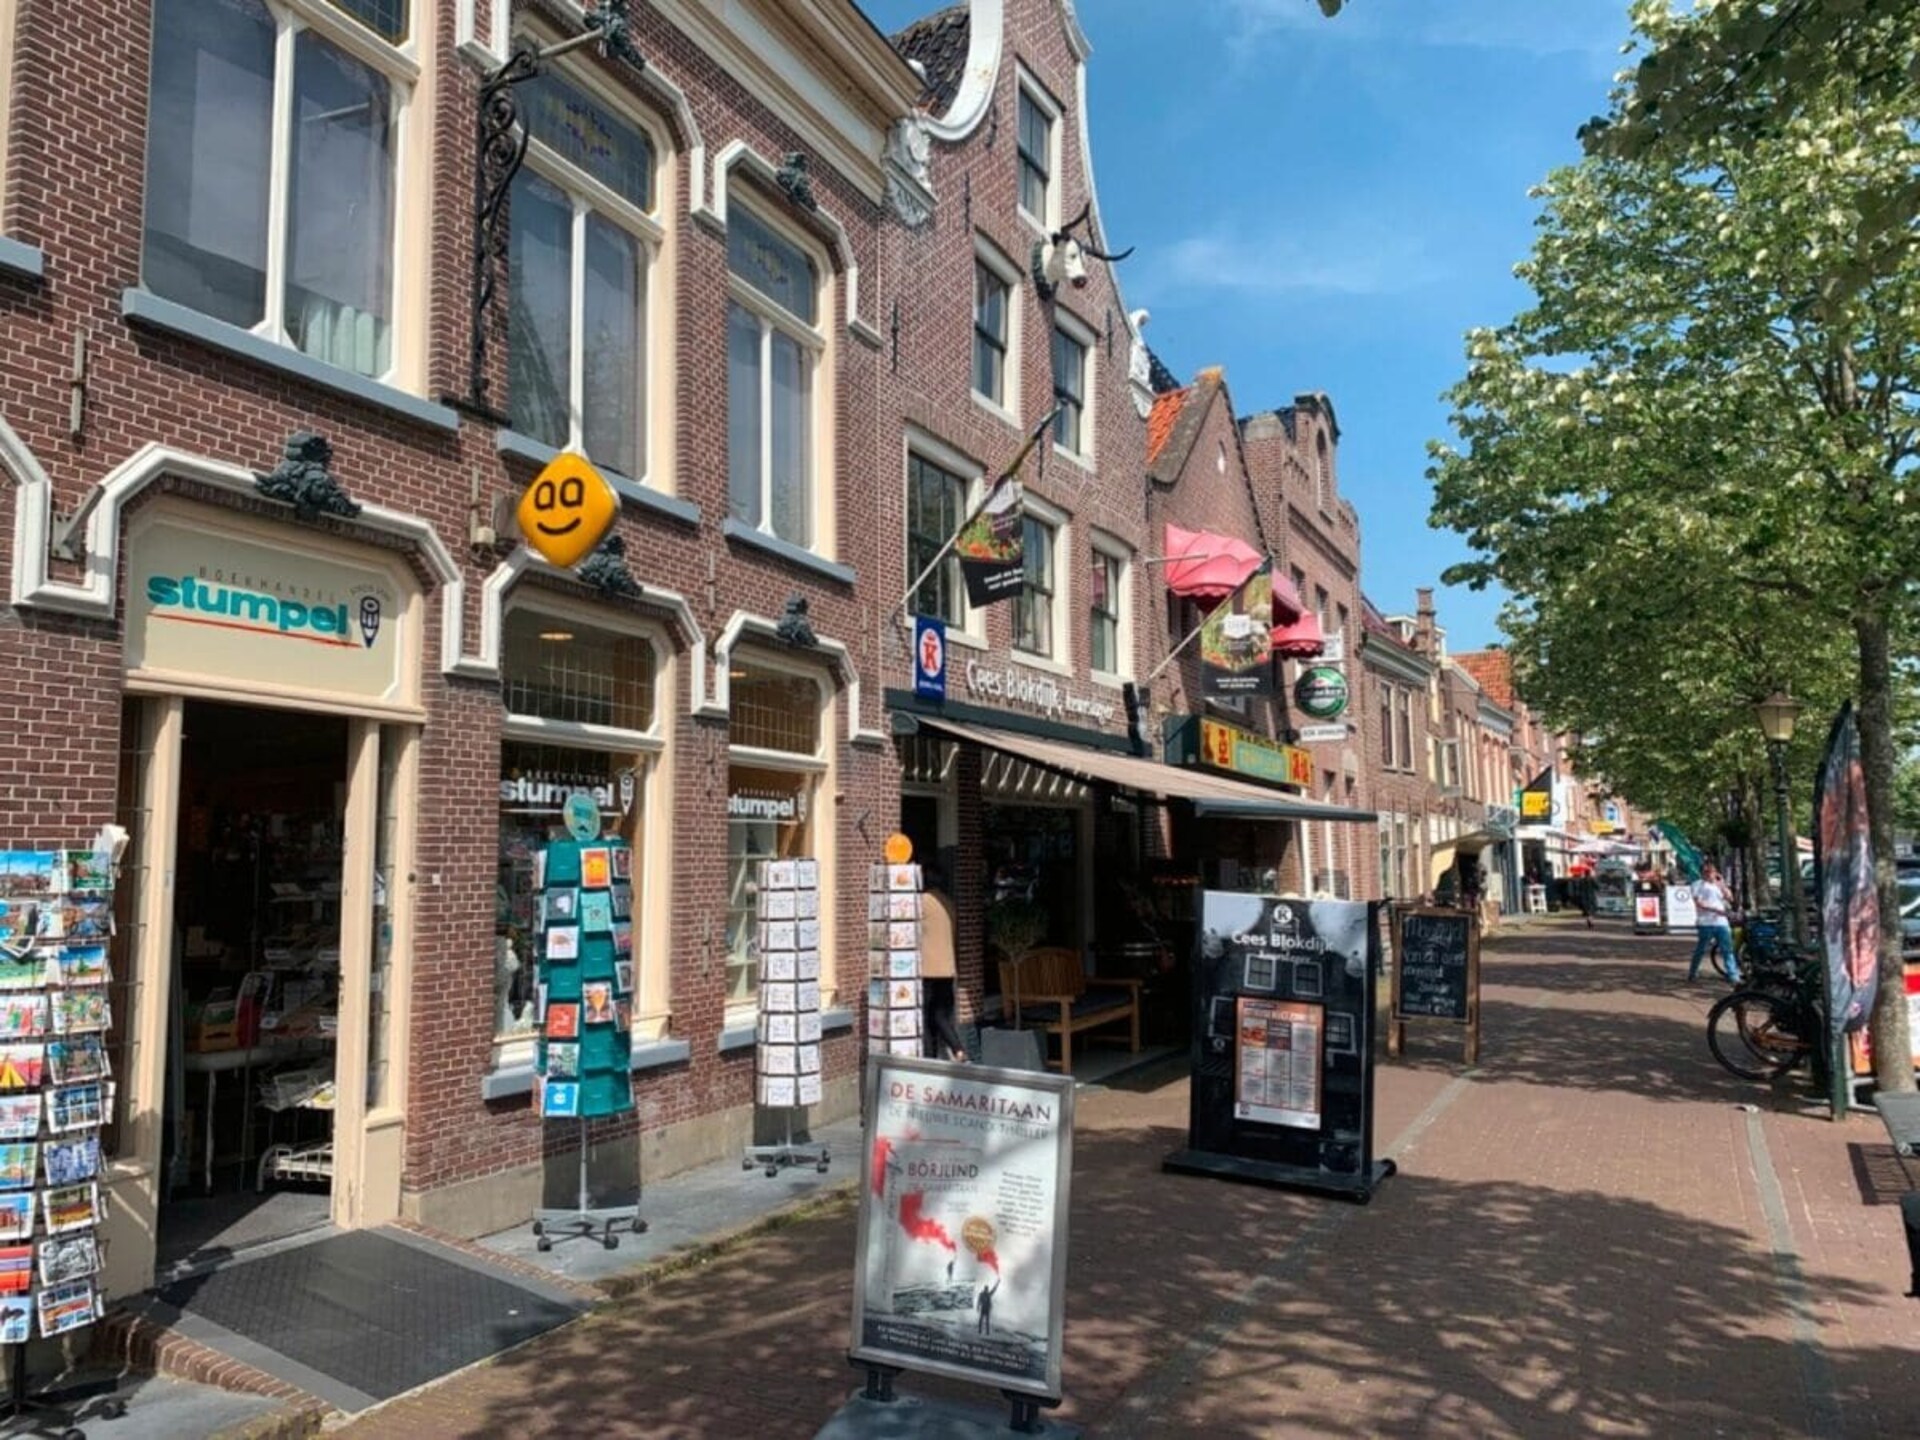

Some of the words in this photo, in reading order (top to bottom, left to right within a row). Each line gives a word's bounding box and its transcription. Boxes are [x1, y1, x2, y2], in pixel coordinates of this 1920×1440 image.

[147, 575, 349, 636] stumpel
[966, 659, 1000, 696] Cees
[1231, 930, 1268, 947] Cees
[1271, 933, 1334, 956] Blokdijk
[890, 1082, 915, 1100] DE
[923, 1087, 1051, 1122] SAMARITAAN
